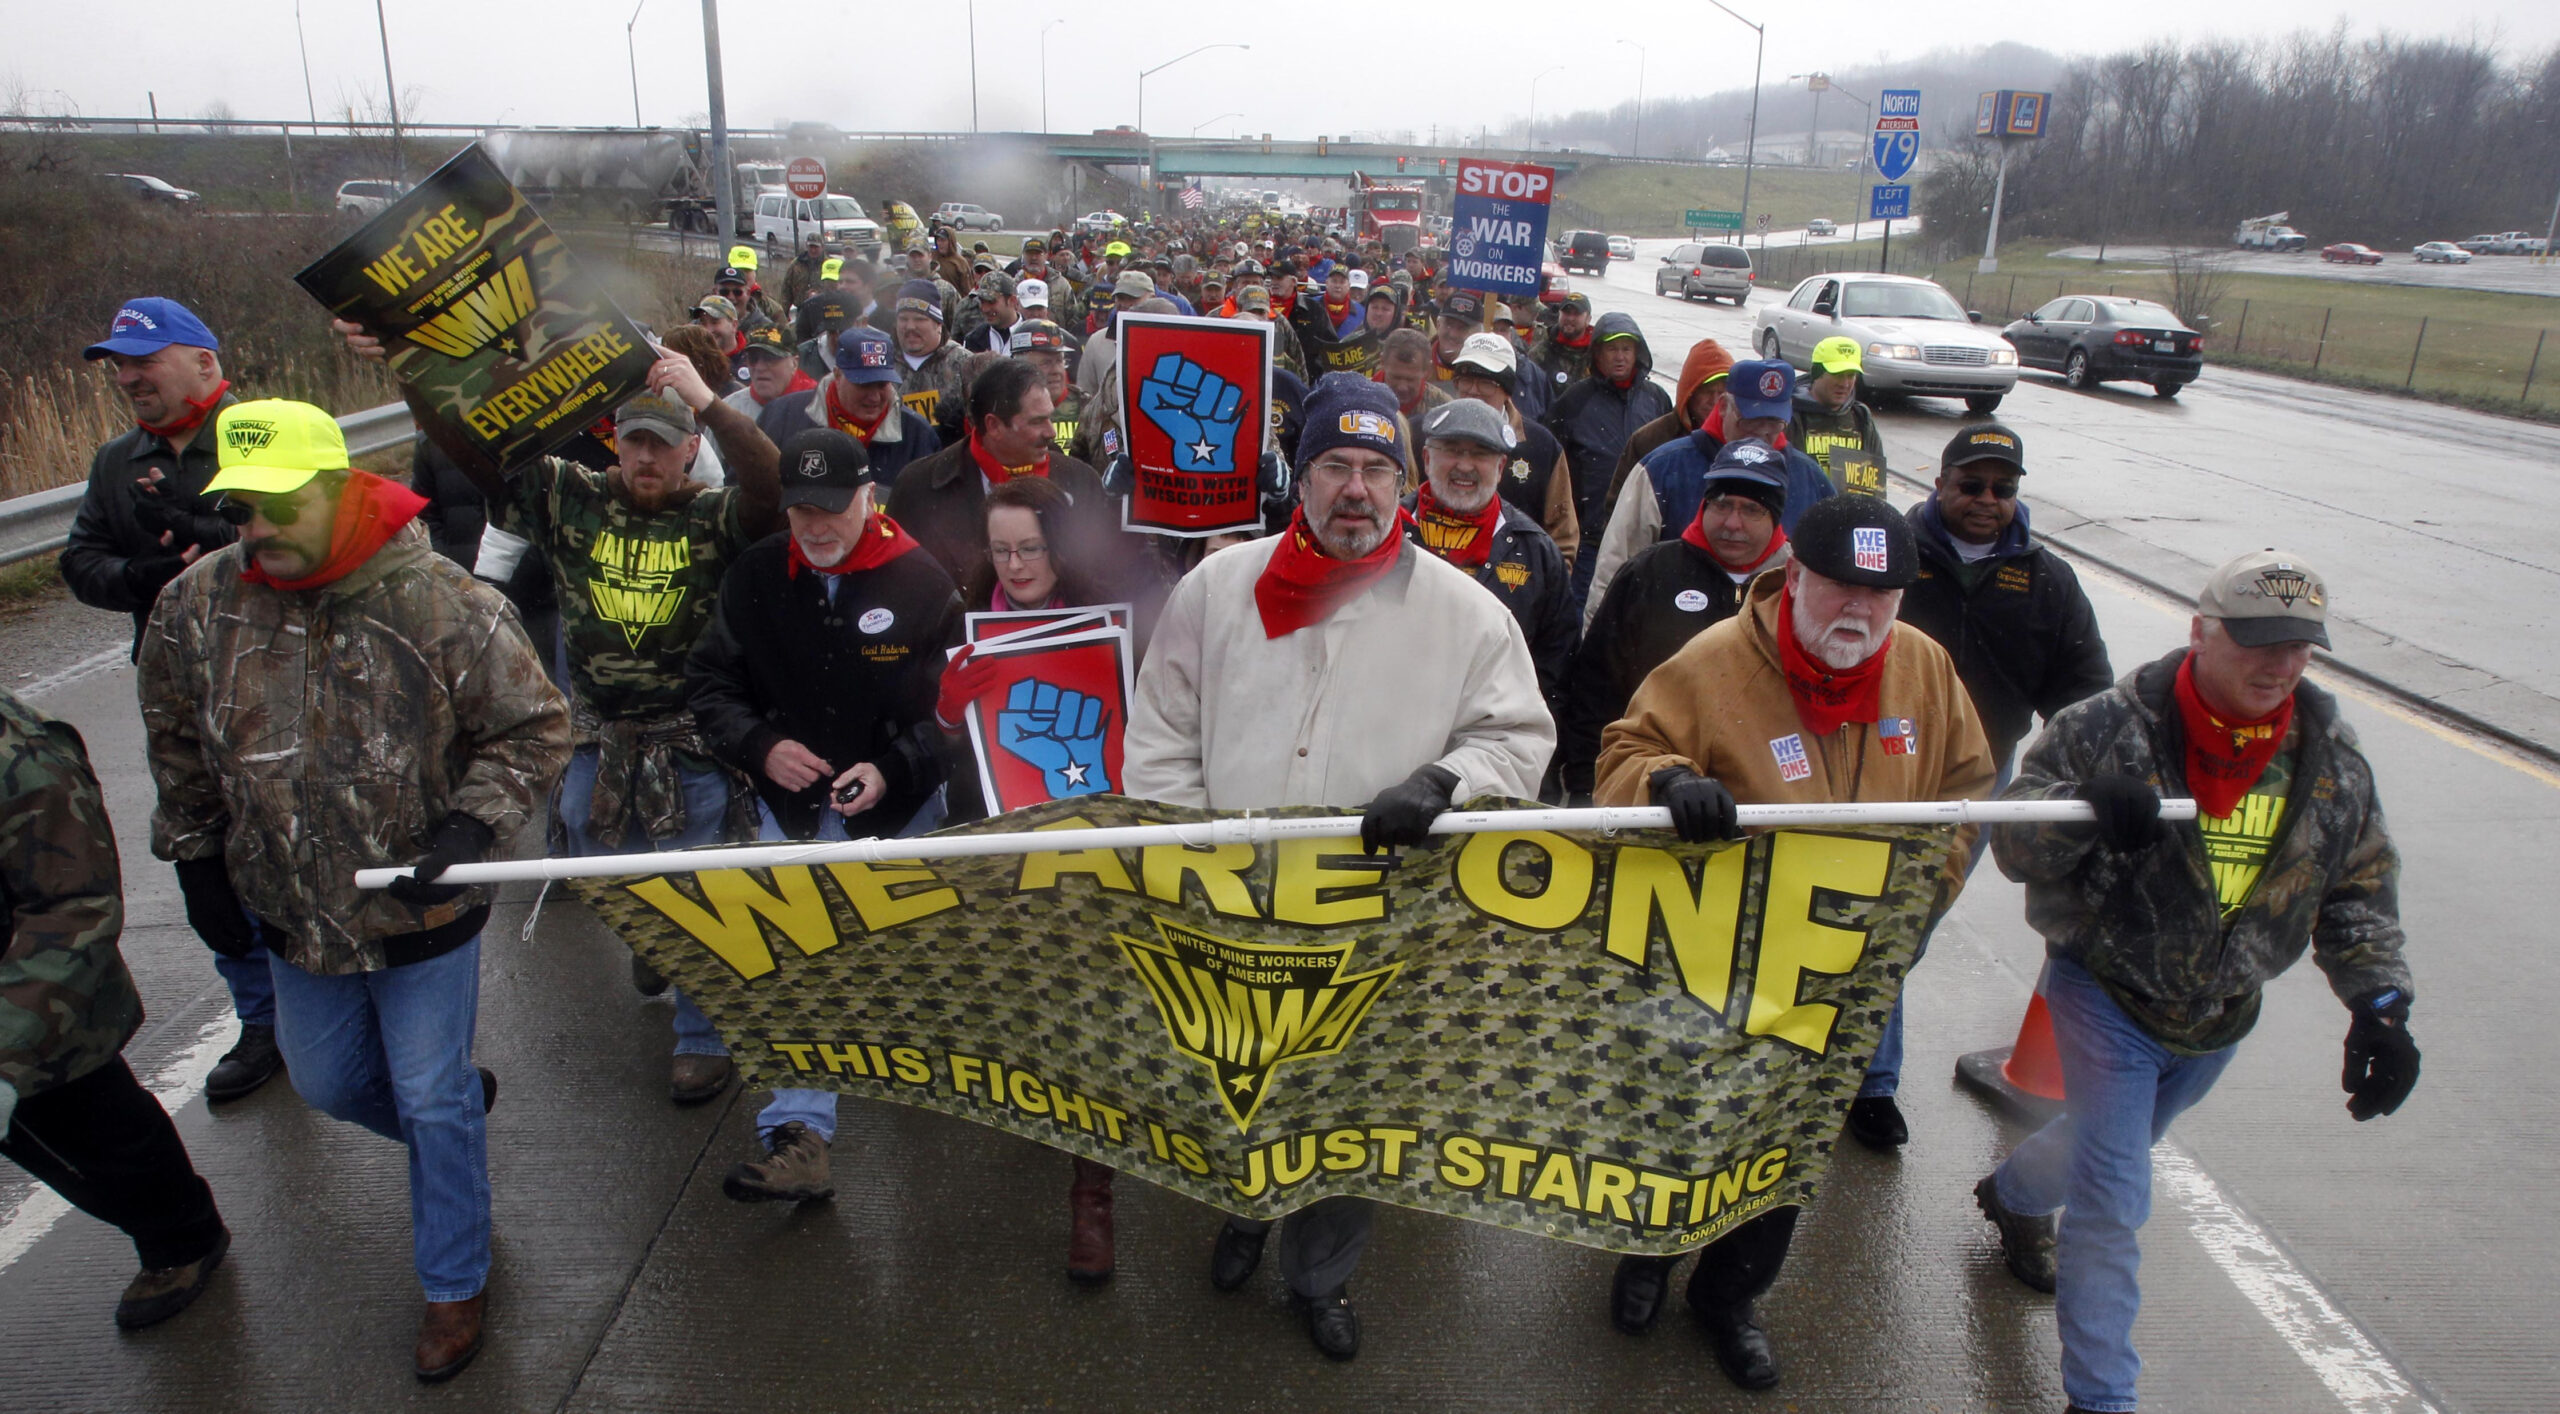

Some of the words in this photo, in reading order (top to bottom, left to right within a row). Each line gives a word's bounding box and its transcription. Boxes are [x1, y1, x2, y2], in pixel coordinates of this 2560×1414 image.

[1882, 93, 1918, 113] NORTH
[1880, 120, 1915, 130] INTERSTATE
[2014, 119, 2033, 128] ALDI
[1877, 132, 1916, 168] 79
[795, 184, 819, 192] ENTER
[1462, 166, 1549, 199] STOP
[1878, 188, 1904, 200] LEFT
[1491, 203, 1511, 216] THE
[1875, 204, 1904, 217] LANE
[1471, 216, 1532, 247] WAR
[362, 243, 428, 297] WE
[411, 203, 480, 269] ARE
[1488, 248, 1504, 260] ON
[407, 291, 435, 314] UNITED
[433, 277, 455, 297] MINE
[452, 250, 493, 283] WORKERS
[1452, 259, 1537, 285] WORKERS
[433, 295, 445, 308] OF
[443, 272, 480, 300] AMERICA
[403, 255, 538, 358] UMWA
[1326, 351, 1343, 366] WE
[1344, 346, 1365, 365] ARE
[464, 321, 634, 442] EVERYWHERE
[534, 380, 609, 431] www.umwa.org
[227, 431, 272, 447] UMWA
[1339, 413, 1396, 444] USW
[1105, 442, 1118, 453] ONE
[1142, 471, 1197, 490] STAND
[1203, 477, 1248, 491] WITH
[1845, 461, 1861, 485] WE
[1861, 466, 1880, 489] ARE
[1143, 485, 1248, 506] WISCONSIN
[1419, 519, 1480, 550] UMWA
[1855, 530, 1885, 547] WE
[1856, 552, 1886, 570] ONE
[2258, 580, 2311, 598] UMWA
[591, 584, 679, 627] UMWA
[1772, 736, 1802, 758] WE
[1880, 736, 1906, 757] YES
[1780, 759, 1809, 779] ONE
[627, 858, 963, 984] WE
[1017, 814, 1386, 926] ARE
[1456, 829, 1893, 1057] ONE
[1168, 930, 1216, 956] UNITED
[1220, 948, 1255, 967] MINE
[1259, 955, 1337, 969] WORKERS
[1206, 957, 1223, 970] OF
[1227, 965, 1293, 984] AMERICA
[1132, 946, 1379, 1067] UMWA
[771, 1041, 932, 1085] THIS
[950, 1055, 1131, 1142] FIGHT
[1148, 1119, 1212, 1176] IS
[1230, 1127, 1417, 1197] JUST
[1440, 1137, 1789, 1229] STARTING
[1680, 1211, 1735, 1245] DONATED
[1737, 1191, 1777, 1217] LABOR
